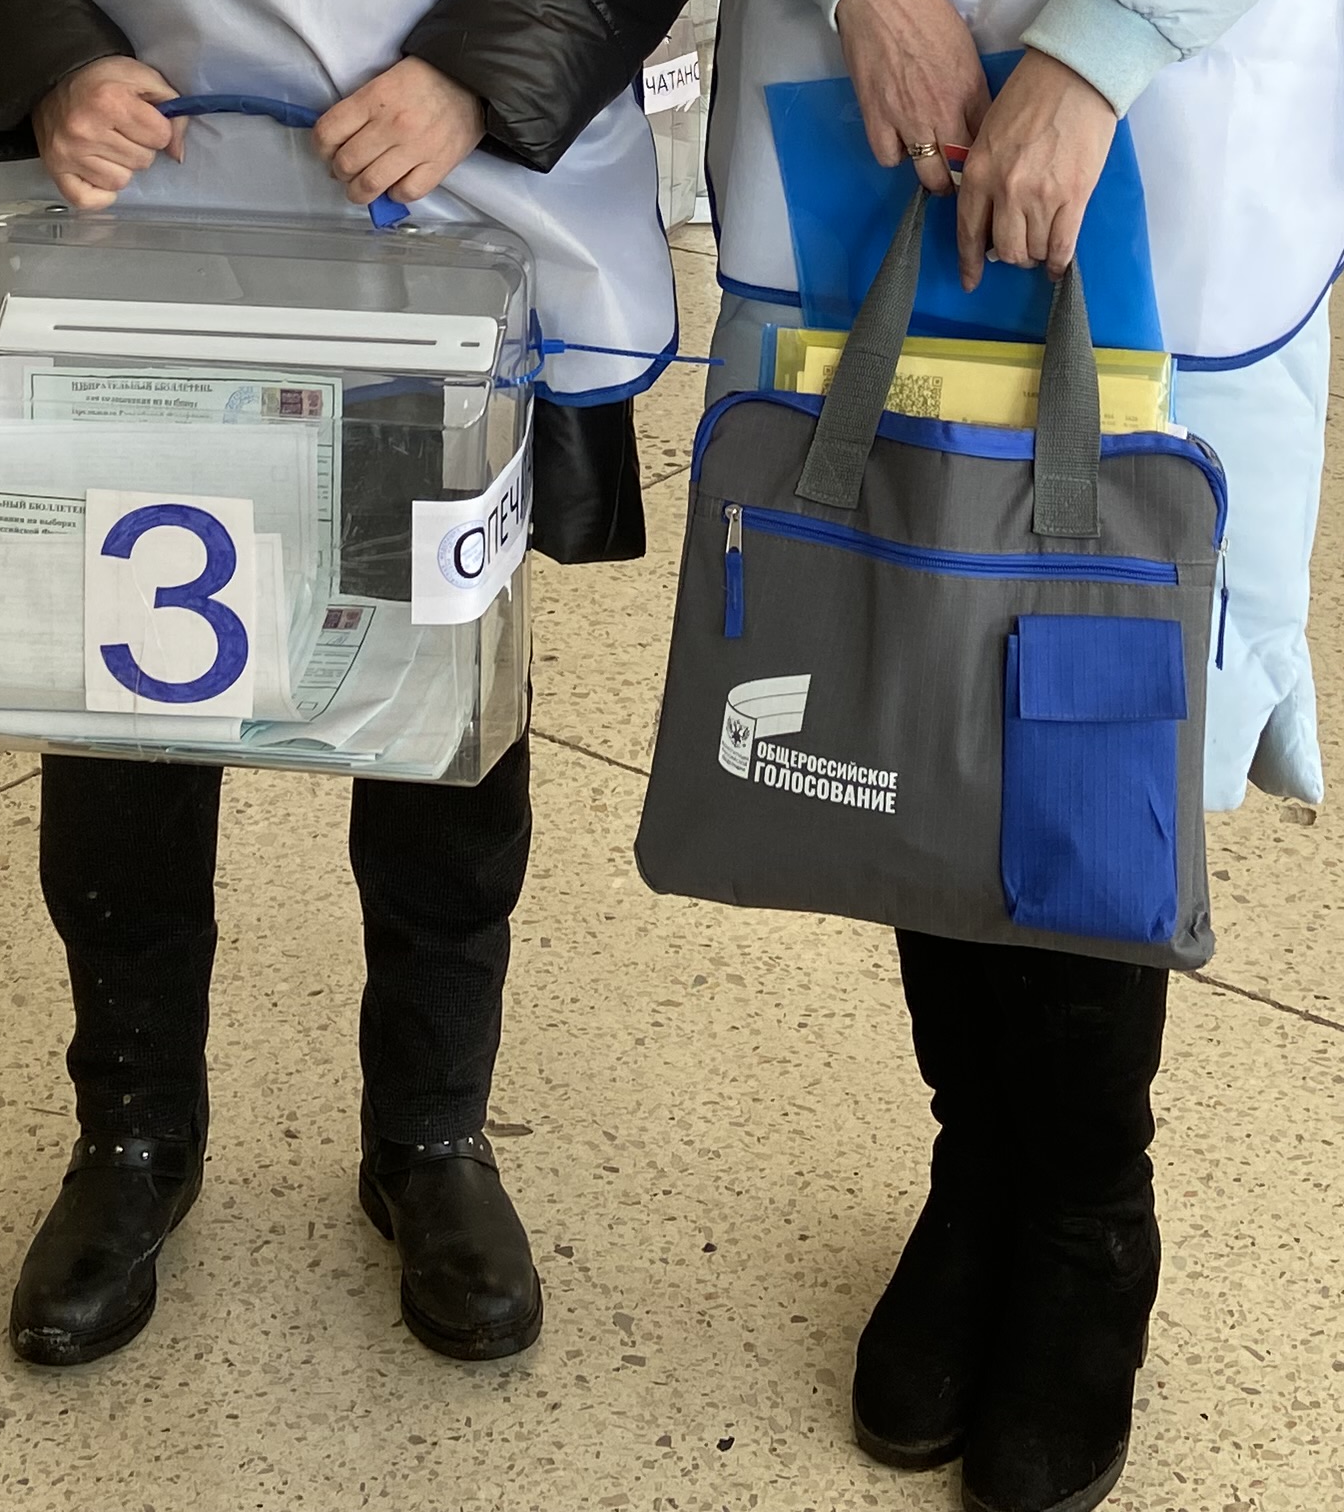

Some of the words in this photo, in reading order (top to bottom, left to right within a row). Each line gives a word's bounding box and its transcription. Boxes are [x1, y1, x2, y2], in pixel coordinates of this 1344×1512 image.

[454, 466, 526, 579] ОПЕЧ
[99, 502, 250, 704] 3
[753, 760, 898, 815] ГОЛОСОВАНИЕ
[756, 740, 899, 790] ОБЩЕРОССИЙСКОЕ
